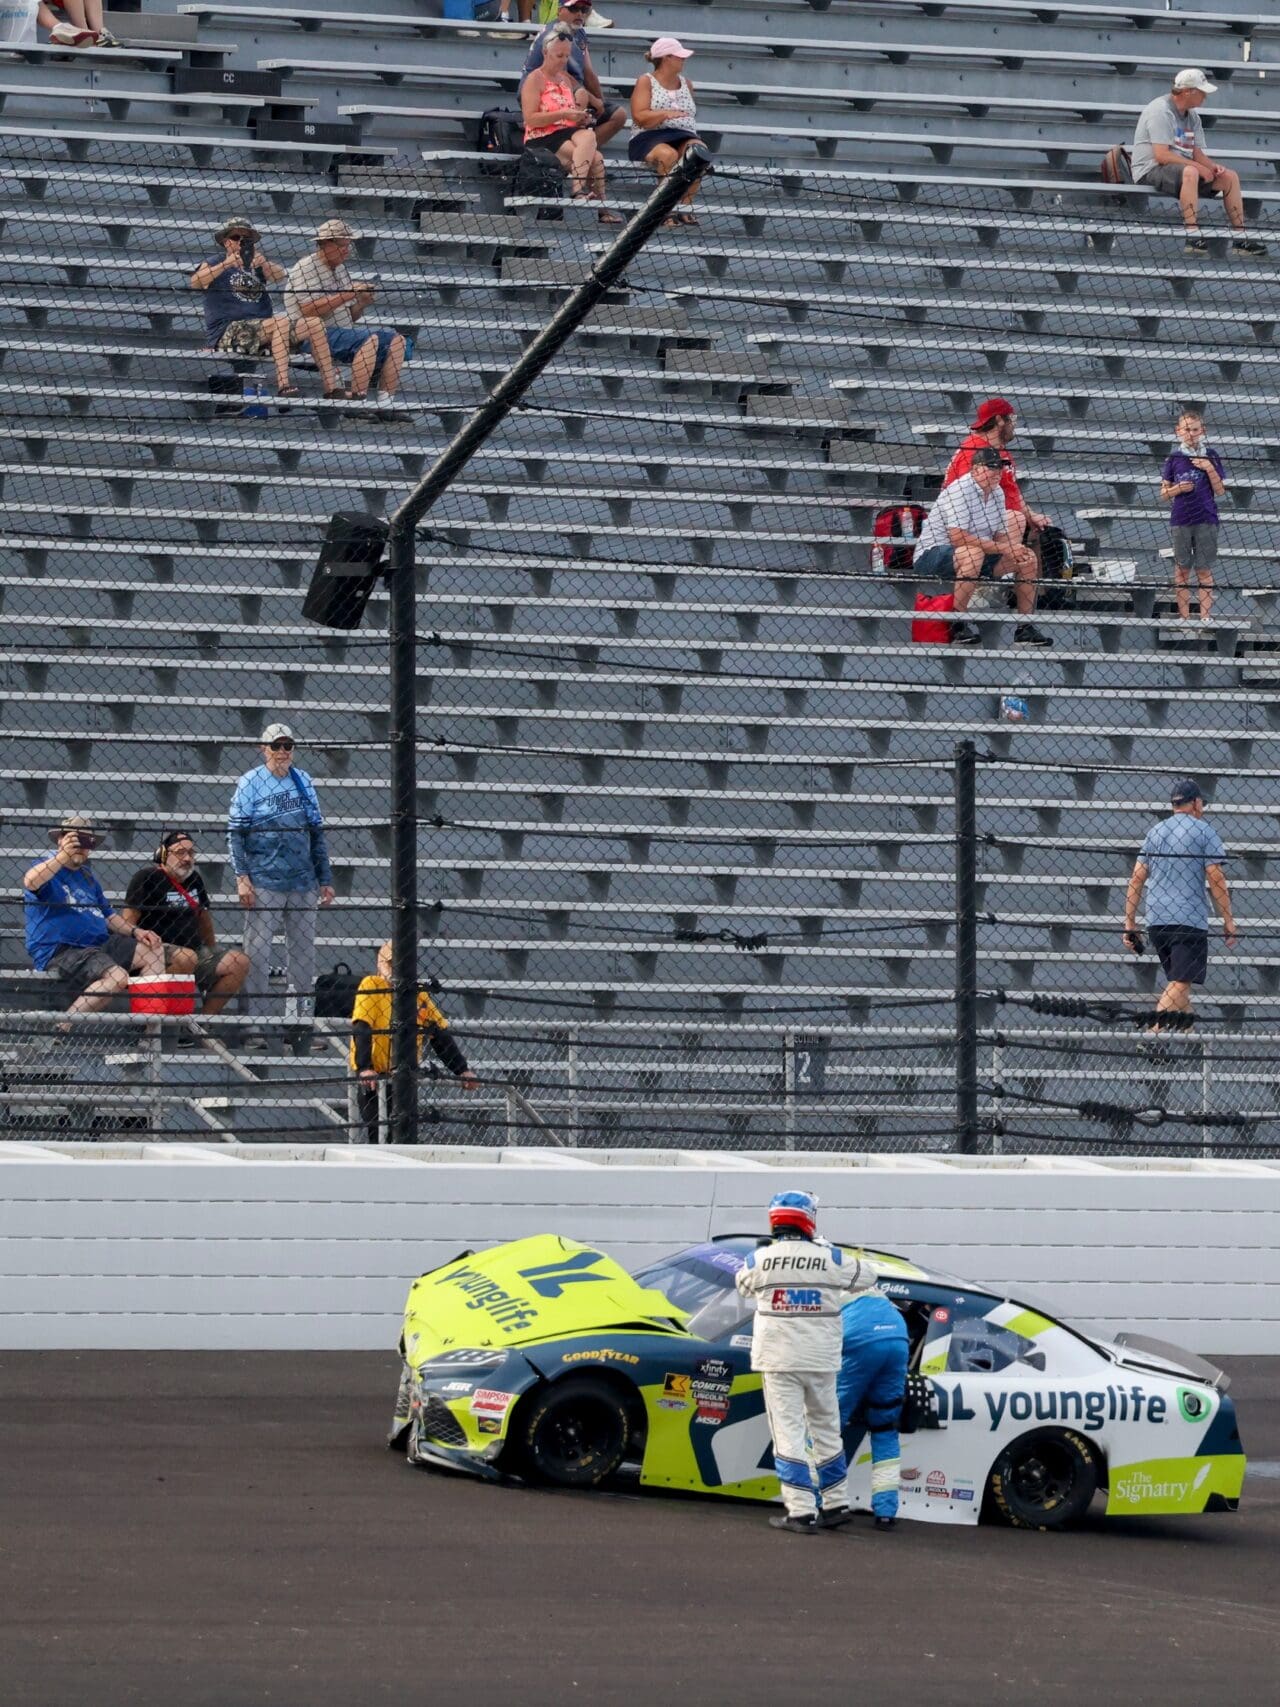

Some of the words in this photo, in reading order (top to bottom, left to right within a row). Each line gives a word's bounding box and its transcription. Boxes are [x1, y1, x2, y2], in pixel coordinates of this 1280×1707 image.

[223, 73, 235, 83] CC
[798, 1051, 811, 1083] 2
[762, 1256, 828, 1271] OFFICIAL
[772, 1289, 823, 1305] AMR
[562, 1349, 640, 1364] GOODYEAR
[691, 1380, 730, 1392] COMETIC
[475, 1390, 510, 1402] SIMPSON
[984, 1385, 1167, 1431] younglife
[695, 1416, 722, 1425] MSD
[1132, 1472, 1153, 1483] The
[1116, 1480, 1189, 1503] Signatry
